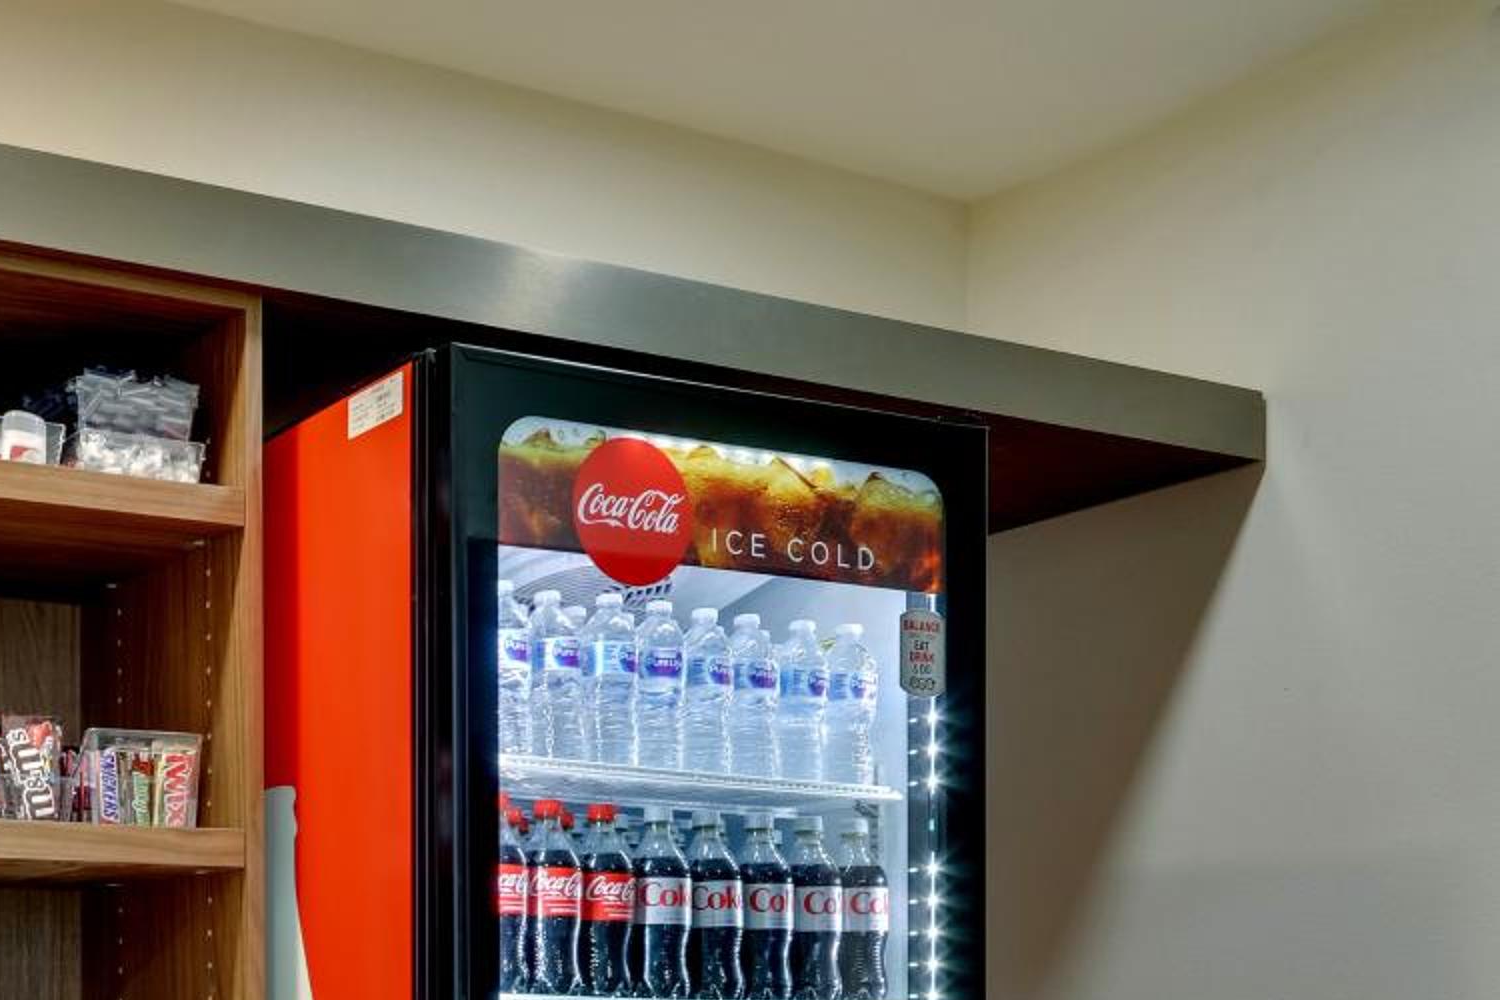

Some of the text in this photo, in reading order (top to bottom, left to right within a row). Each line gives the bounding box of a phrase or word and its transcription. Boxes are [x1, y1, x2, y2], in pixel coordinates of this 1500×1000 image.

[577, 483, 684, 534] Coca-Cola
[710, 529, 876, 572] ICE COLD
